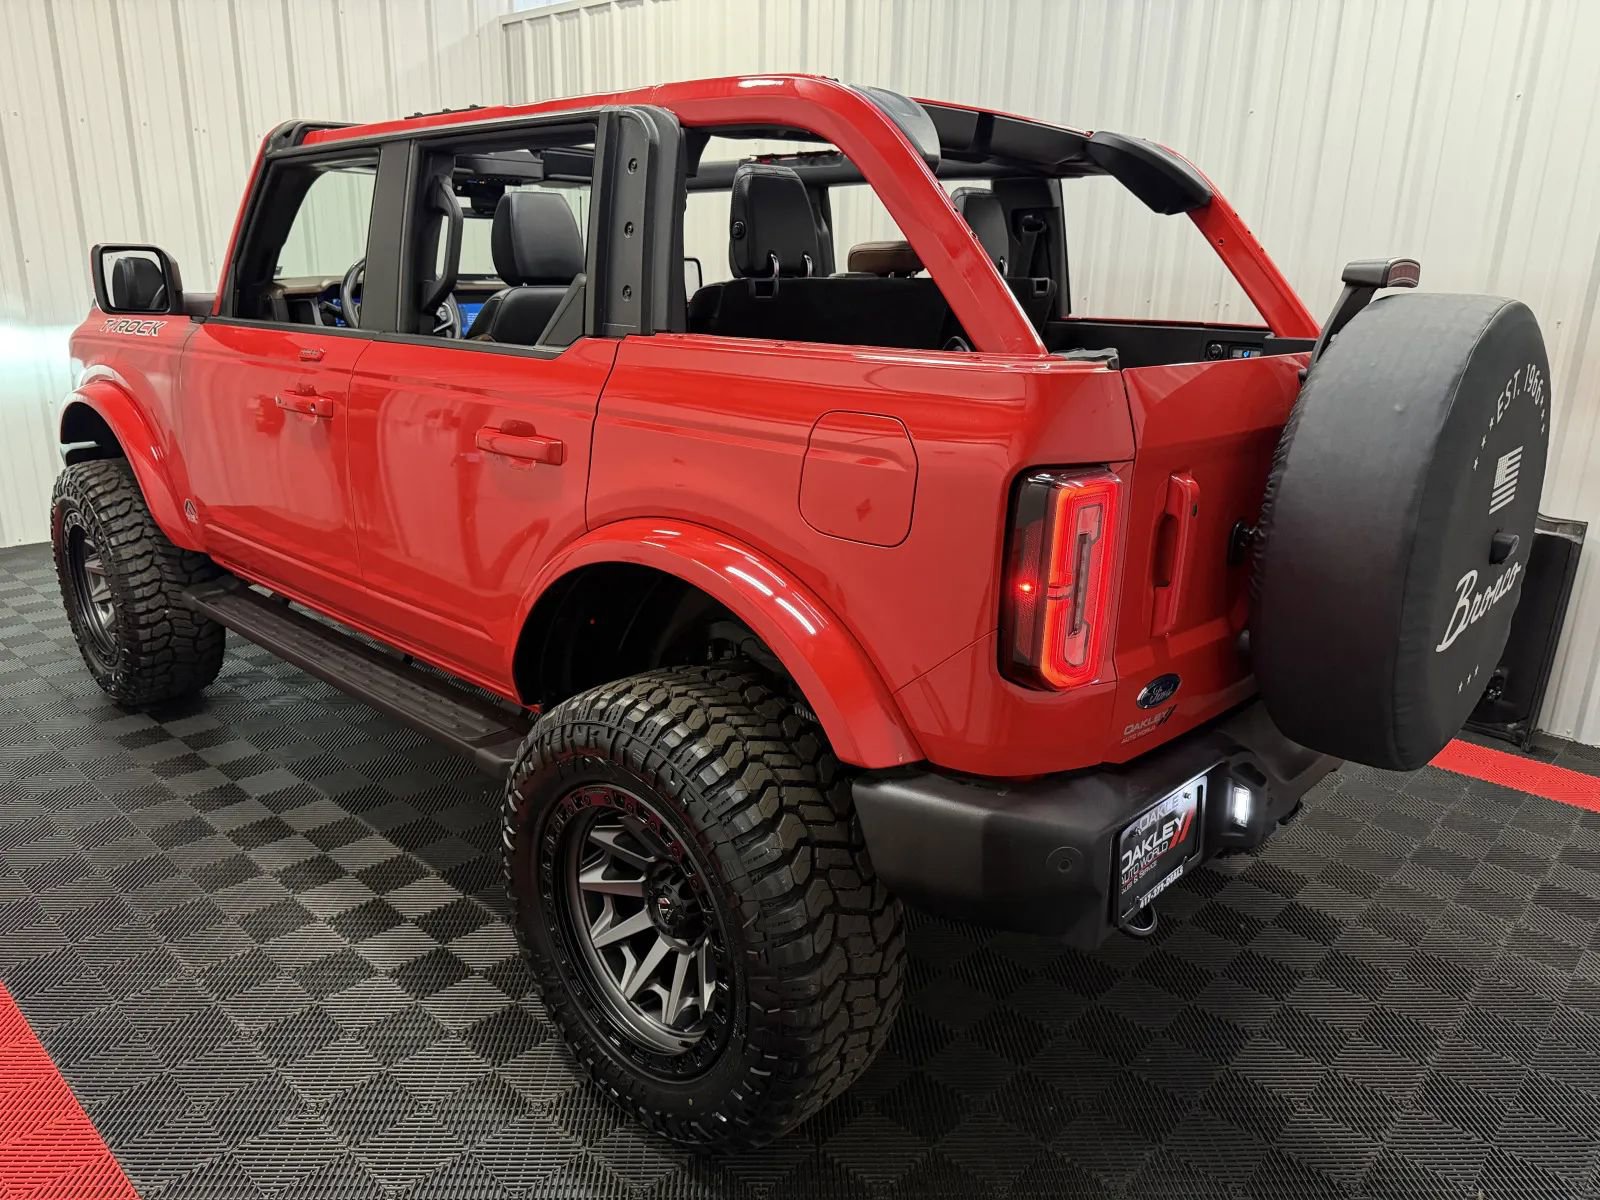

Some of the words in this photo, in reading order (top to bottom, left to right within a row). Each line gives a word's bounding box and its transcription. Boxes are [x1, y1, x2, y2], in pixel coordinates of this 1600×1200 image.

[1496, 368, 1521, 425] EST.
[1523, 363, 1544, 405] 1966
[1435, 561, 1522, 653] Bronco
[1123, 709, 1169, 736] OAKLEY
[1140, 841, 1168, 868] WORLD
